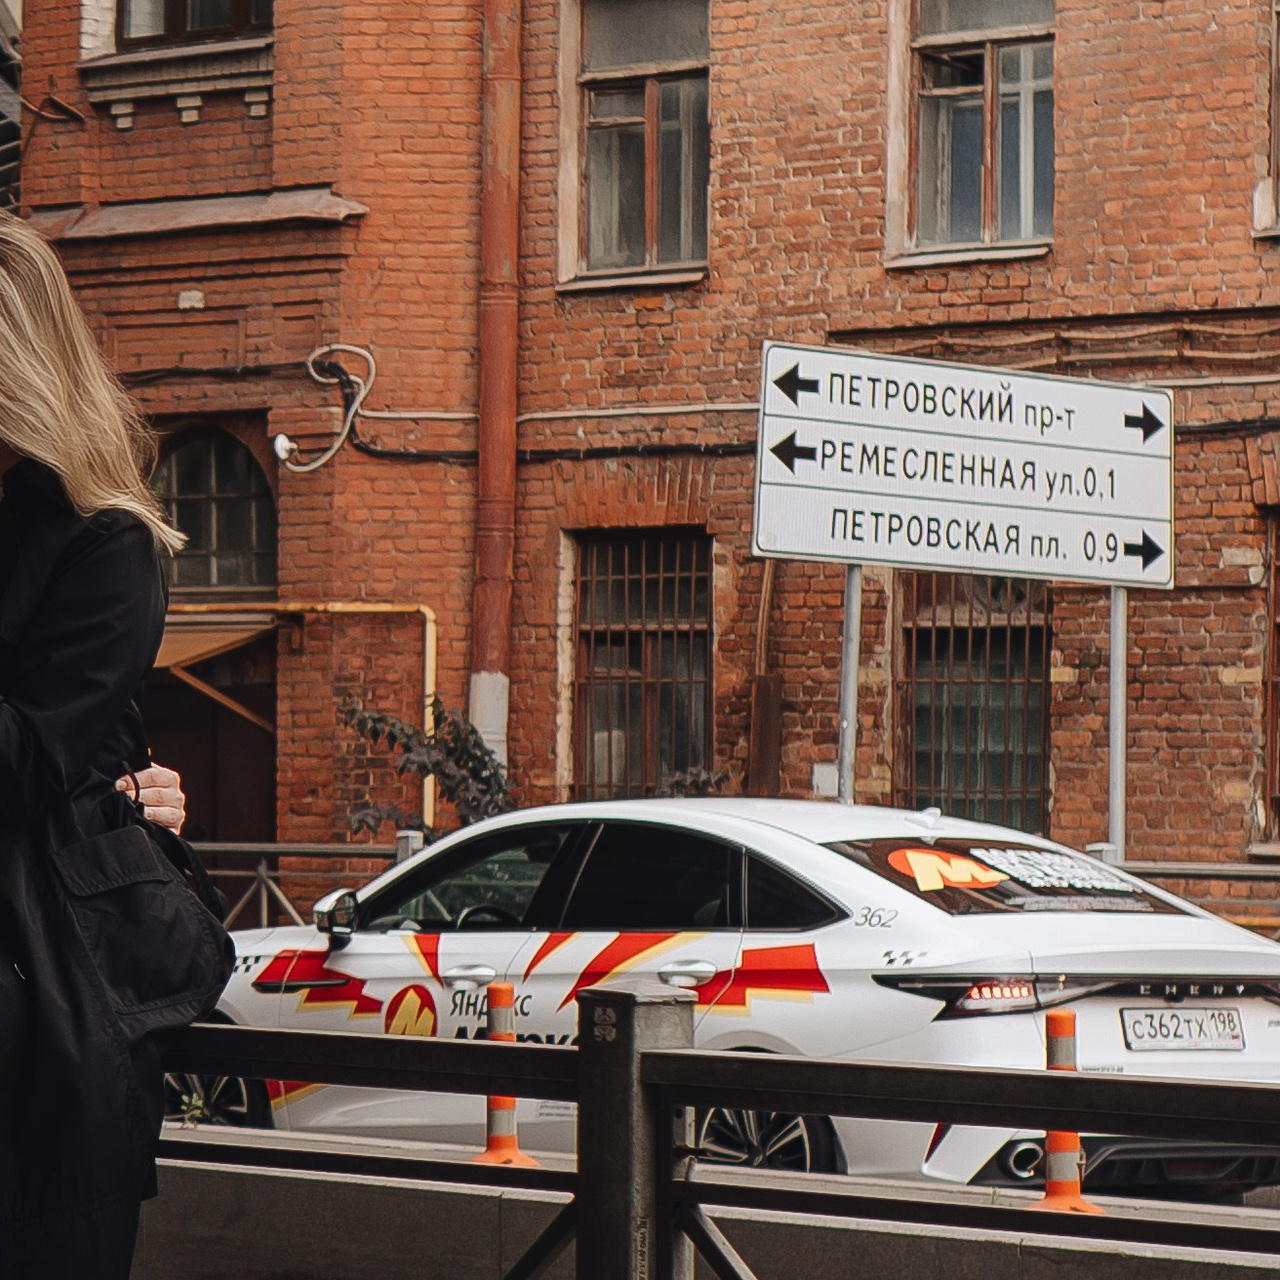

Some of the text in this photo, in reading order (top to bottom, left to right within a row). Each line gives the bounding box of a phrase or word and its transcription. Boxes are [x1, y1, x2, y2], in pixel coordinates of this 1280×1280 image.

[829, 372, 1075, 437] ПЕТРОВСКИЙ пр-т
[821, 440, 1036, 492] РЕМЕСЛЕННАЯ
[831, 508, 1118, 566] ПЕТРОВСКАЯ пл. 0,9
[855, 906, 899, 928] 362
[1210, 1012, 1237, 1033] 198
